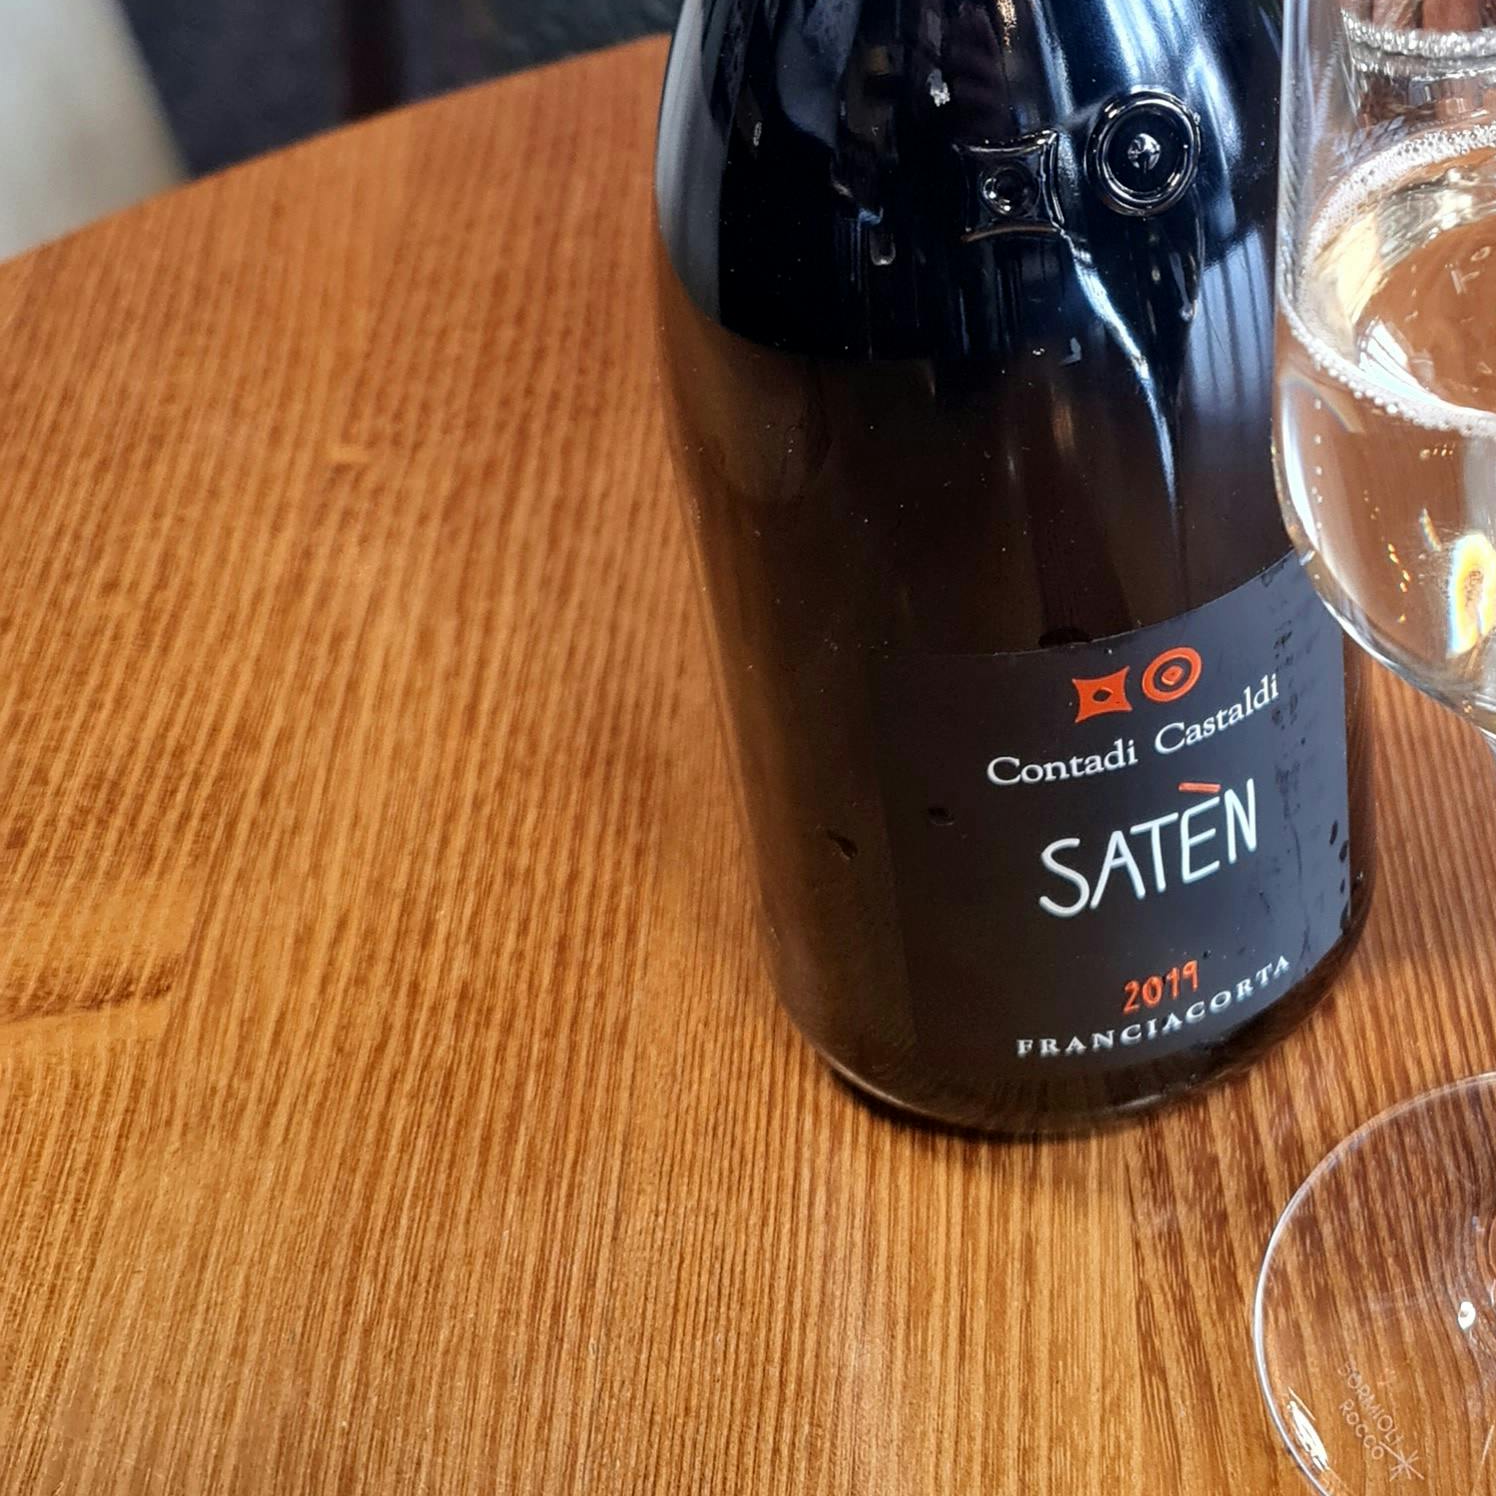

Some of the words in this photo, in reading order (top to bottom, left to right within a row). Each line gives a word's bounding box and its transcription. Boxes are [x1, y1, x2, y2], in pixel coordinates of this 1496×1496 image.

[987, 739, 1138, 785] Contadi
[1154, 673, 1279, 754] Castaldi
[1038, 778, 1257, 917] SATÈN
[1017, 955, 1290, 1058] FRANCIACORTA
[1123, 960, 1199, 1015] 2019
[1339, 1398, 1384, 1460] ROCCO
